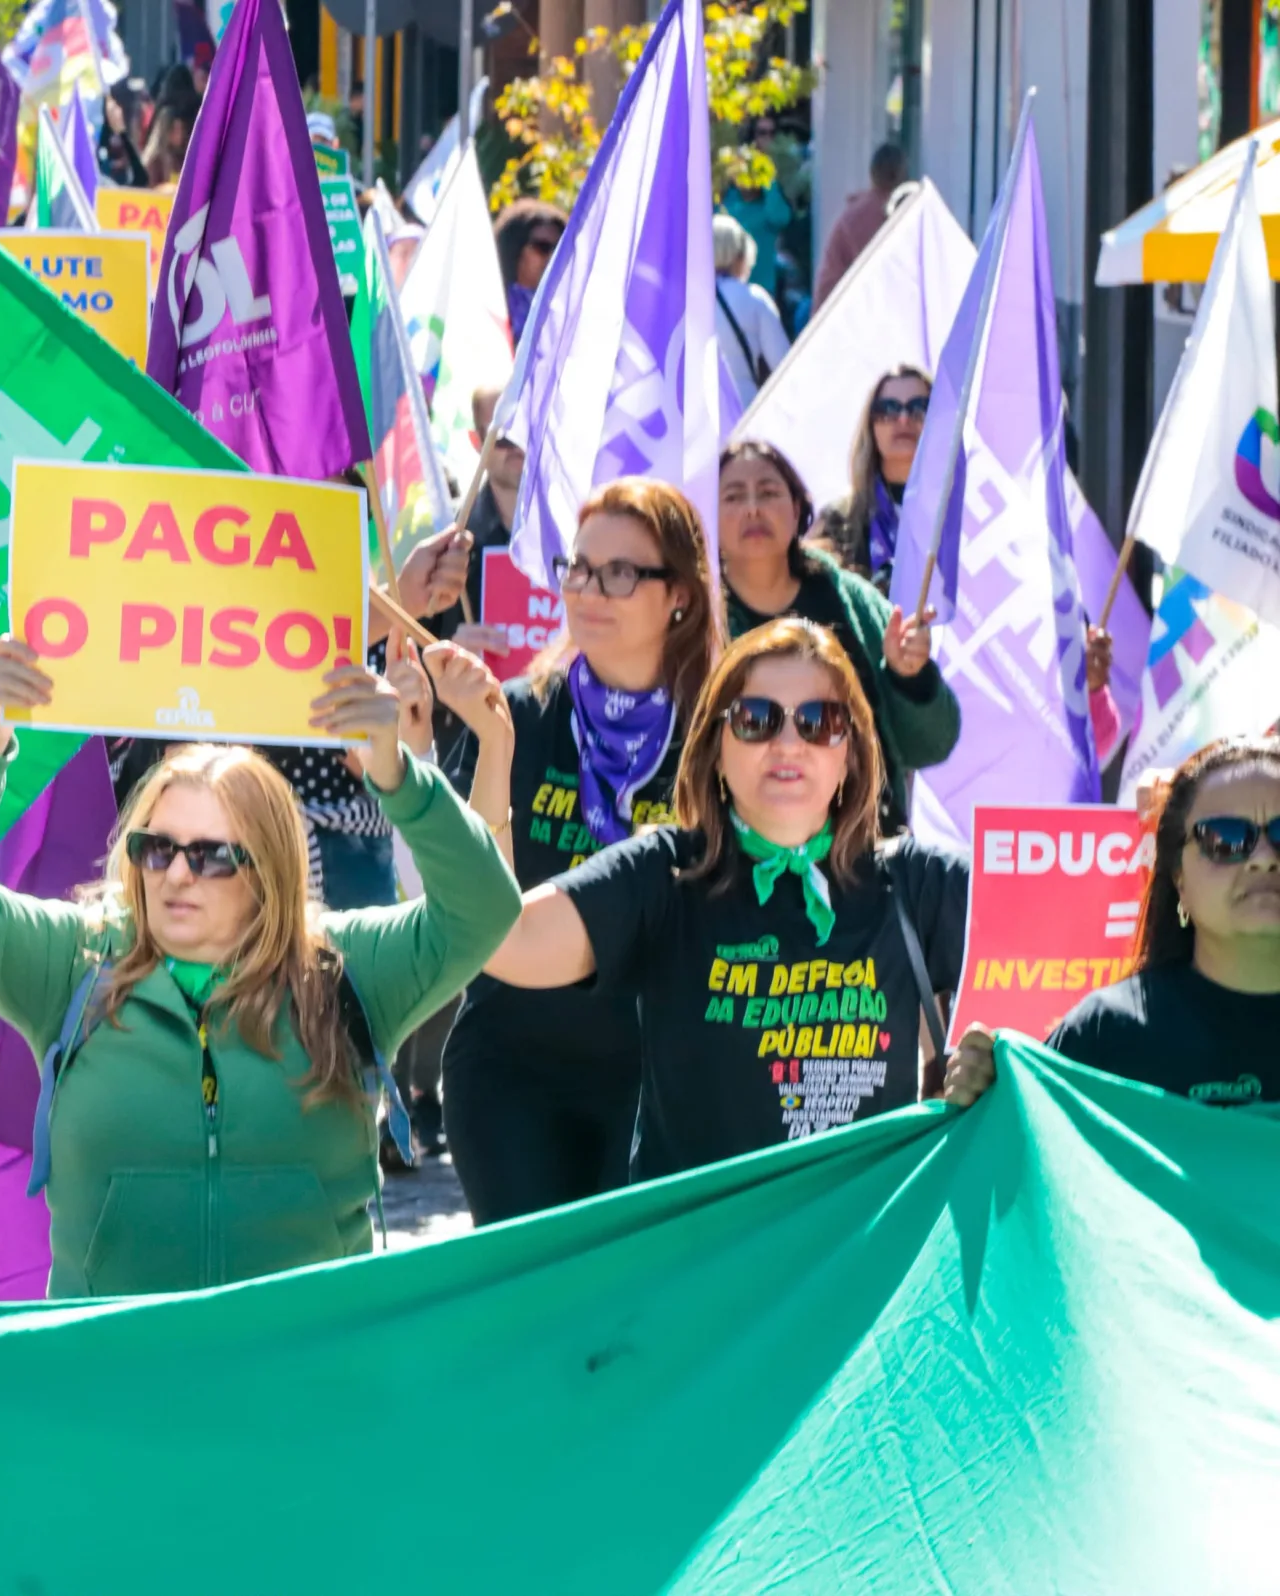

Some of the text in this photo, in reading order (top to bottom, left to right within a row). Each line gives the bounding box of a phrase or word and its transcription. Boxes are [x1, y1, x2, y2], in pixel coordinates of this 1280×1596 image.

[118, 202, 173, 231] PA
[68, 496, 317, 572] PAGA
[22, 597, 353, 671] O PISO!
[531, 783, 578, 821] EM
[529, 816, 552, 845] DA
[708, 956, 877, 997] EM DEFESA
[704, 982, 887, 1029] DA EDUCAÇÃO
[757, 1022, 879, 1059] PÚBLICA!
[803, 1095, 861, 1111] RESPEITO
